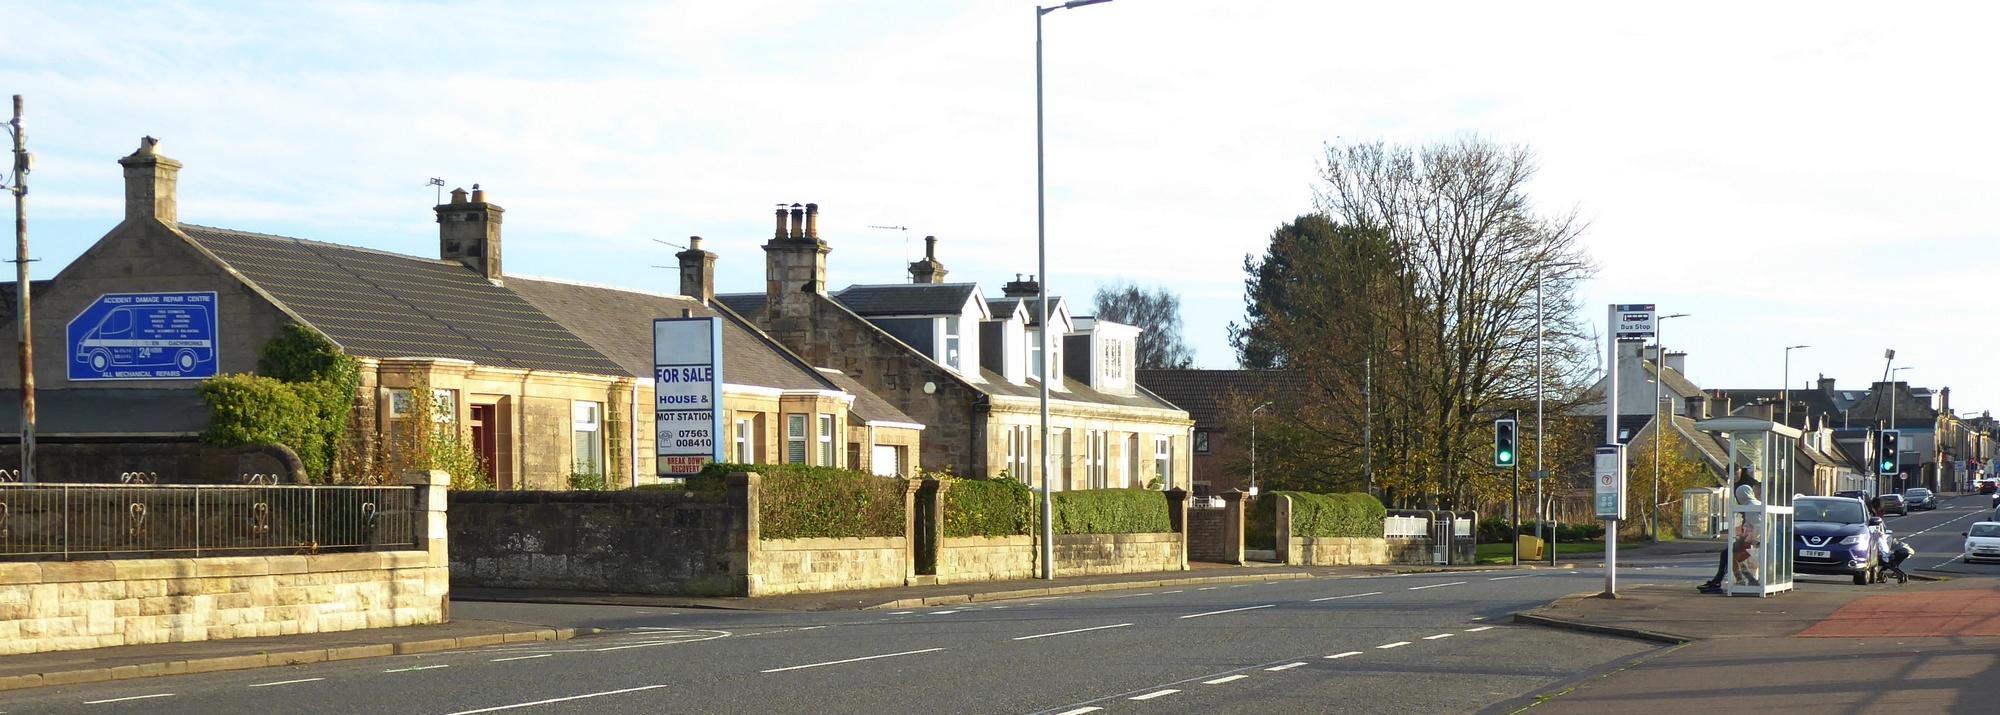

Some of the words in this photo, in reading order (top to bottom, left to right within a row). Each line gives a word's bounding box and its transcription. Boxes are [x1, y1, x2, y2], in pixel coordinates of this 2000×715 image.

[139, 347, 150, 358] 24
[656, 368, 679, 383] FOR
[683, 367, 712, 382] SALE
[660, 395, 697, 404] HOUSE
[700, 394, 709, 403] &
[657, 413, 675, 421] MOT
[677, 412, 713, 421] STATION
[676, 438, 712, 447] 008410
[668, 457, 685, 465] BREAK
[671, 465, 700, 473] RECOVERY
